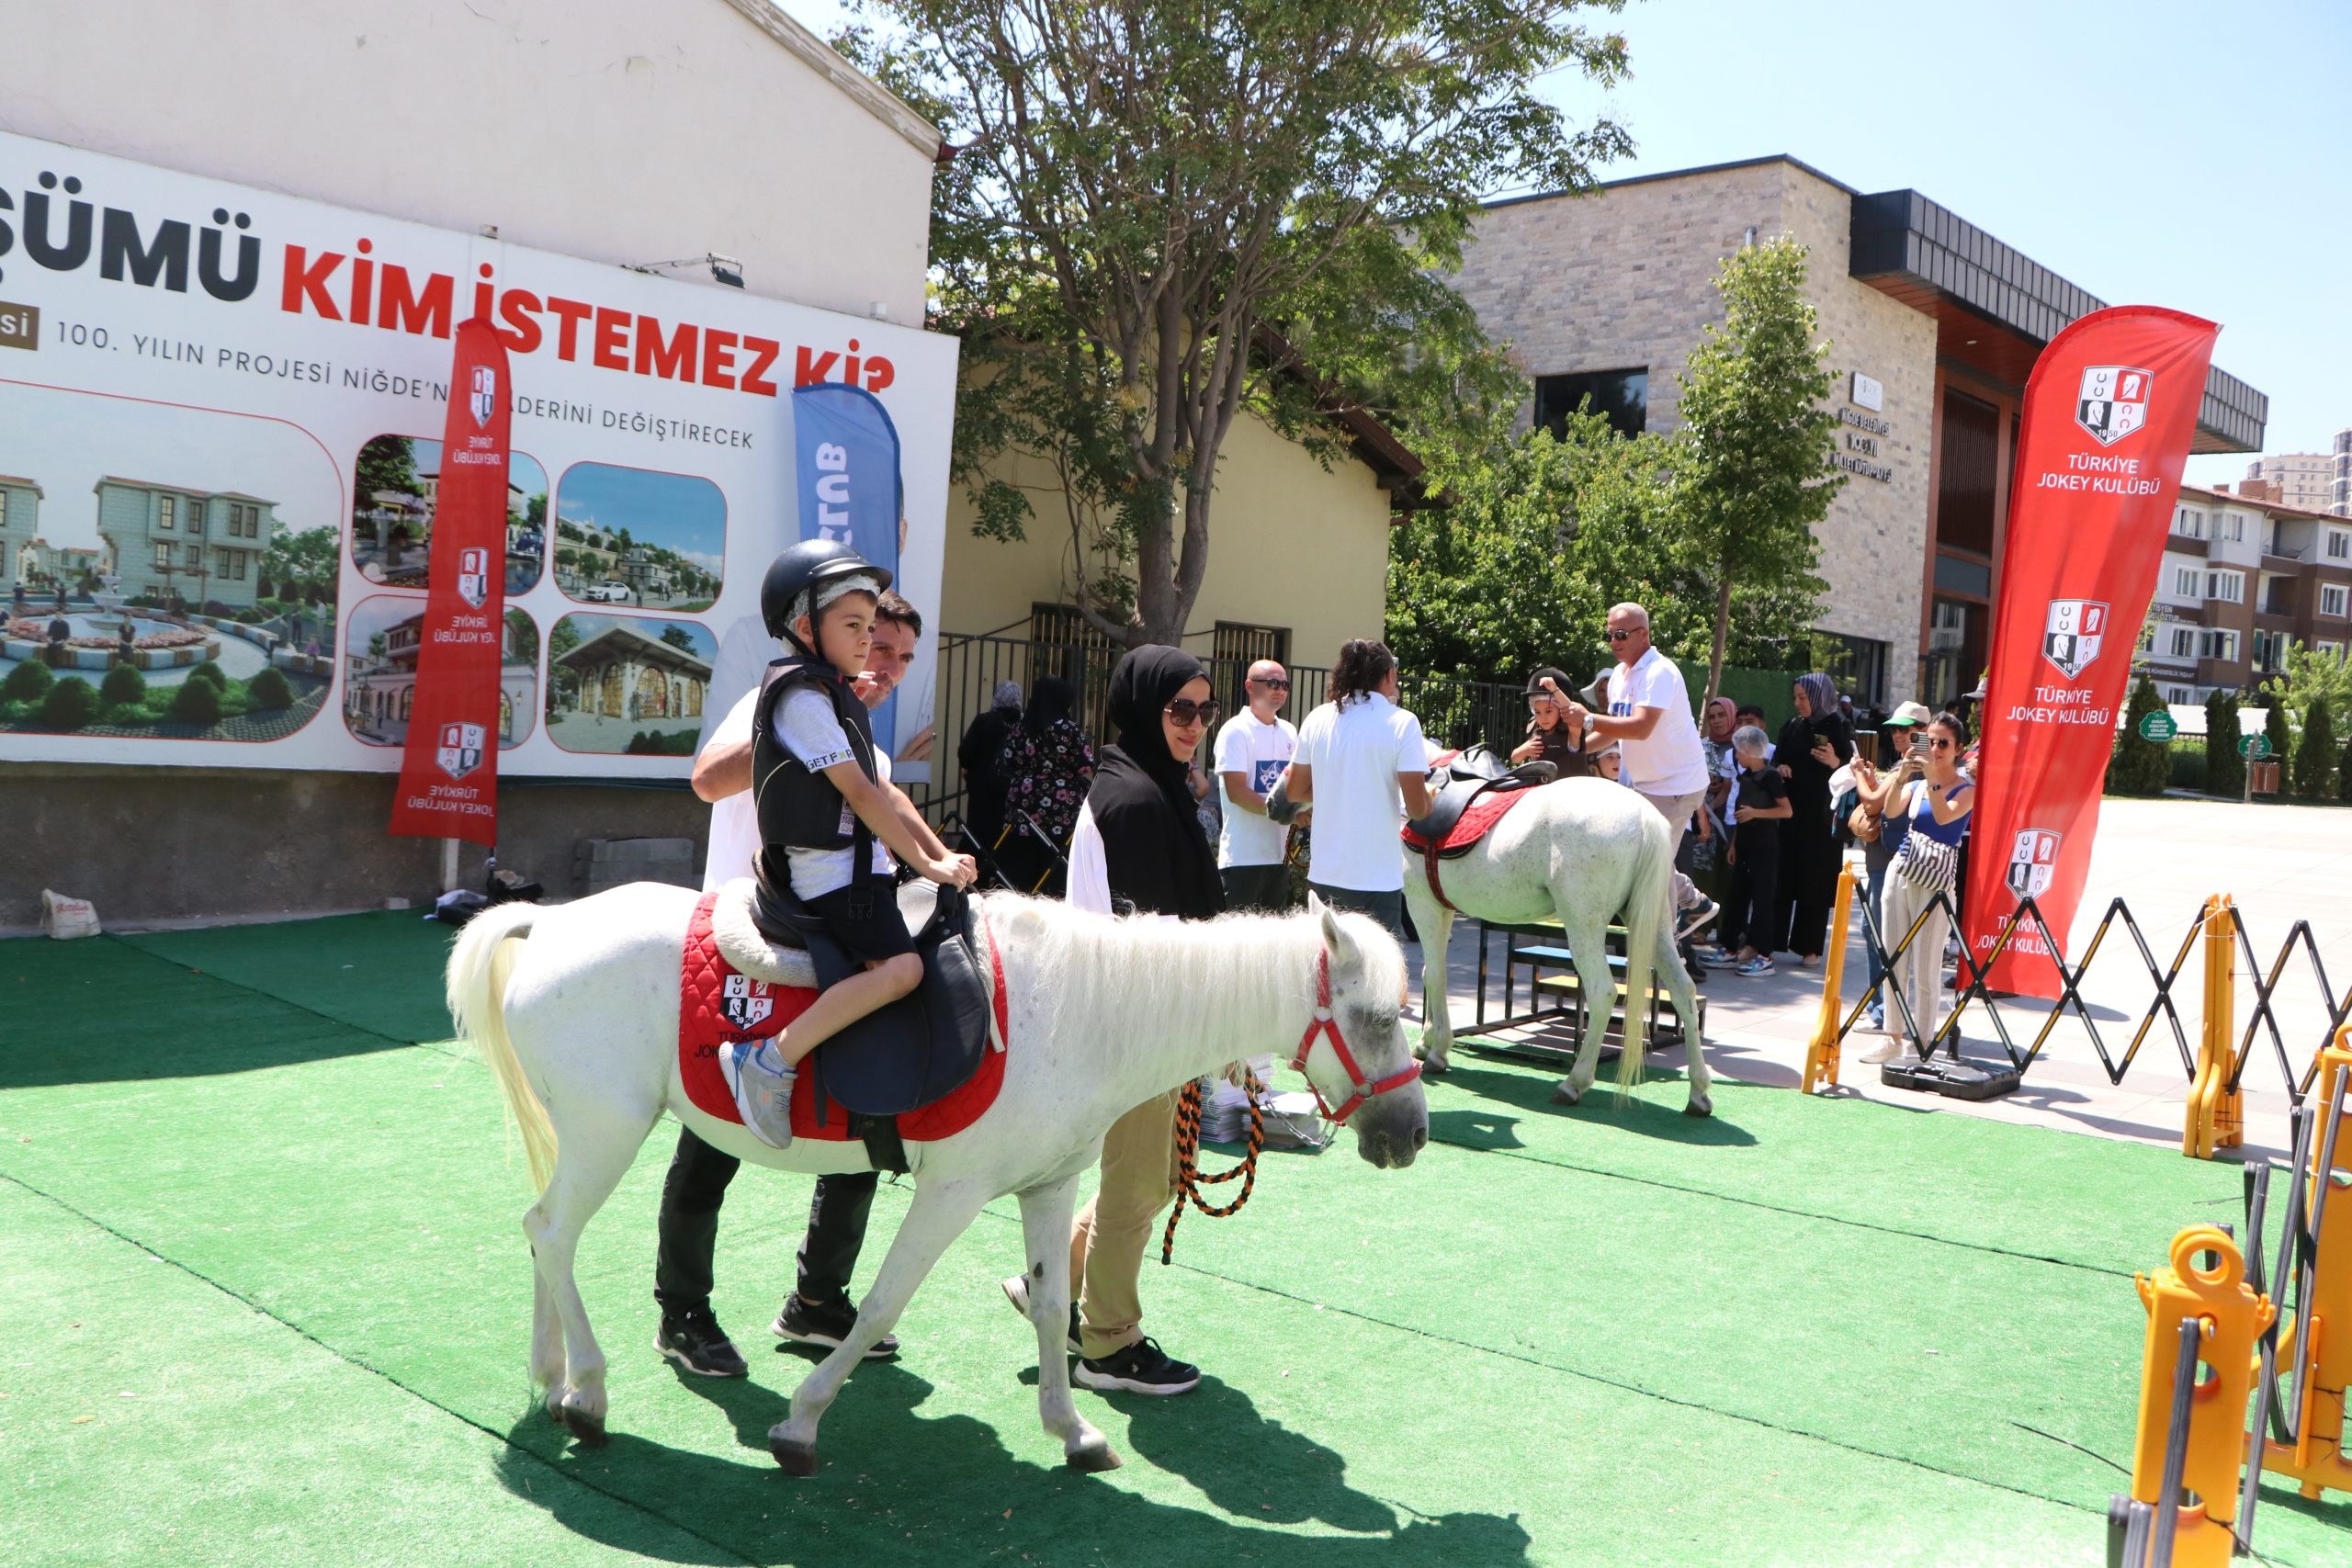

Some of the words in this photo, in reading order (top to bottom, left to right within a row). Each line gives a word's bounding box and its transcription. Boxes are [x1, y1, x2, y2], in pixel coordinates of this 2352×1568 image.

[0, 171, 261, 301] ÜMÜ
[280, 237, 455, 340] KİM
[474, 263, 780, 397] İSTEMEZ
[58, 321, 118, 351] 100.
[132, 333, 204, 365] YILIN
[218, 348, 331, 384] PROJESİ
[343, 367, 447, 401] NİĞDE'N
[511, 396, 593, 424] DERİNİ
[602, 410, 752, 448] DEĞİŞTİRECEK
[2067, 452, 2139, 474] TÜRKİYE
[2037, 472, 2091, 491] JOKEY
[2093, 477, 2161, 495] KULÜBÜ
[2035, 685, 2093, 705] TÜRKİYE
[2007, 705, 2056, 723] JOKEY
[2058, 707, 2109, 725] KULÜBÜ
[1975, 934, 2014, 951] JOKY
[695, 1044, 719, 1057] JOK
